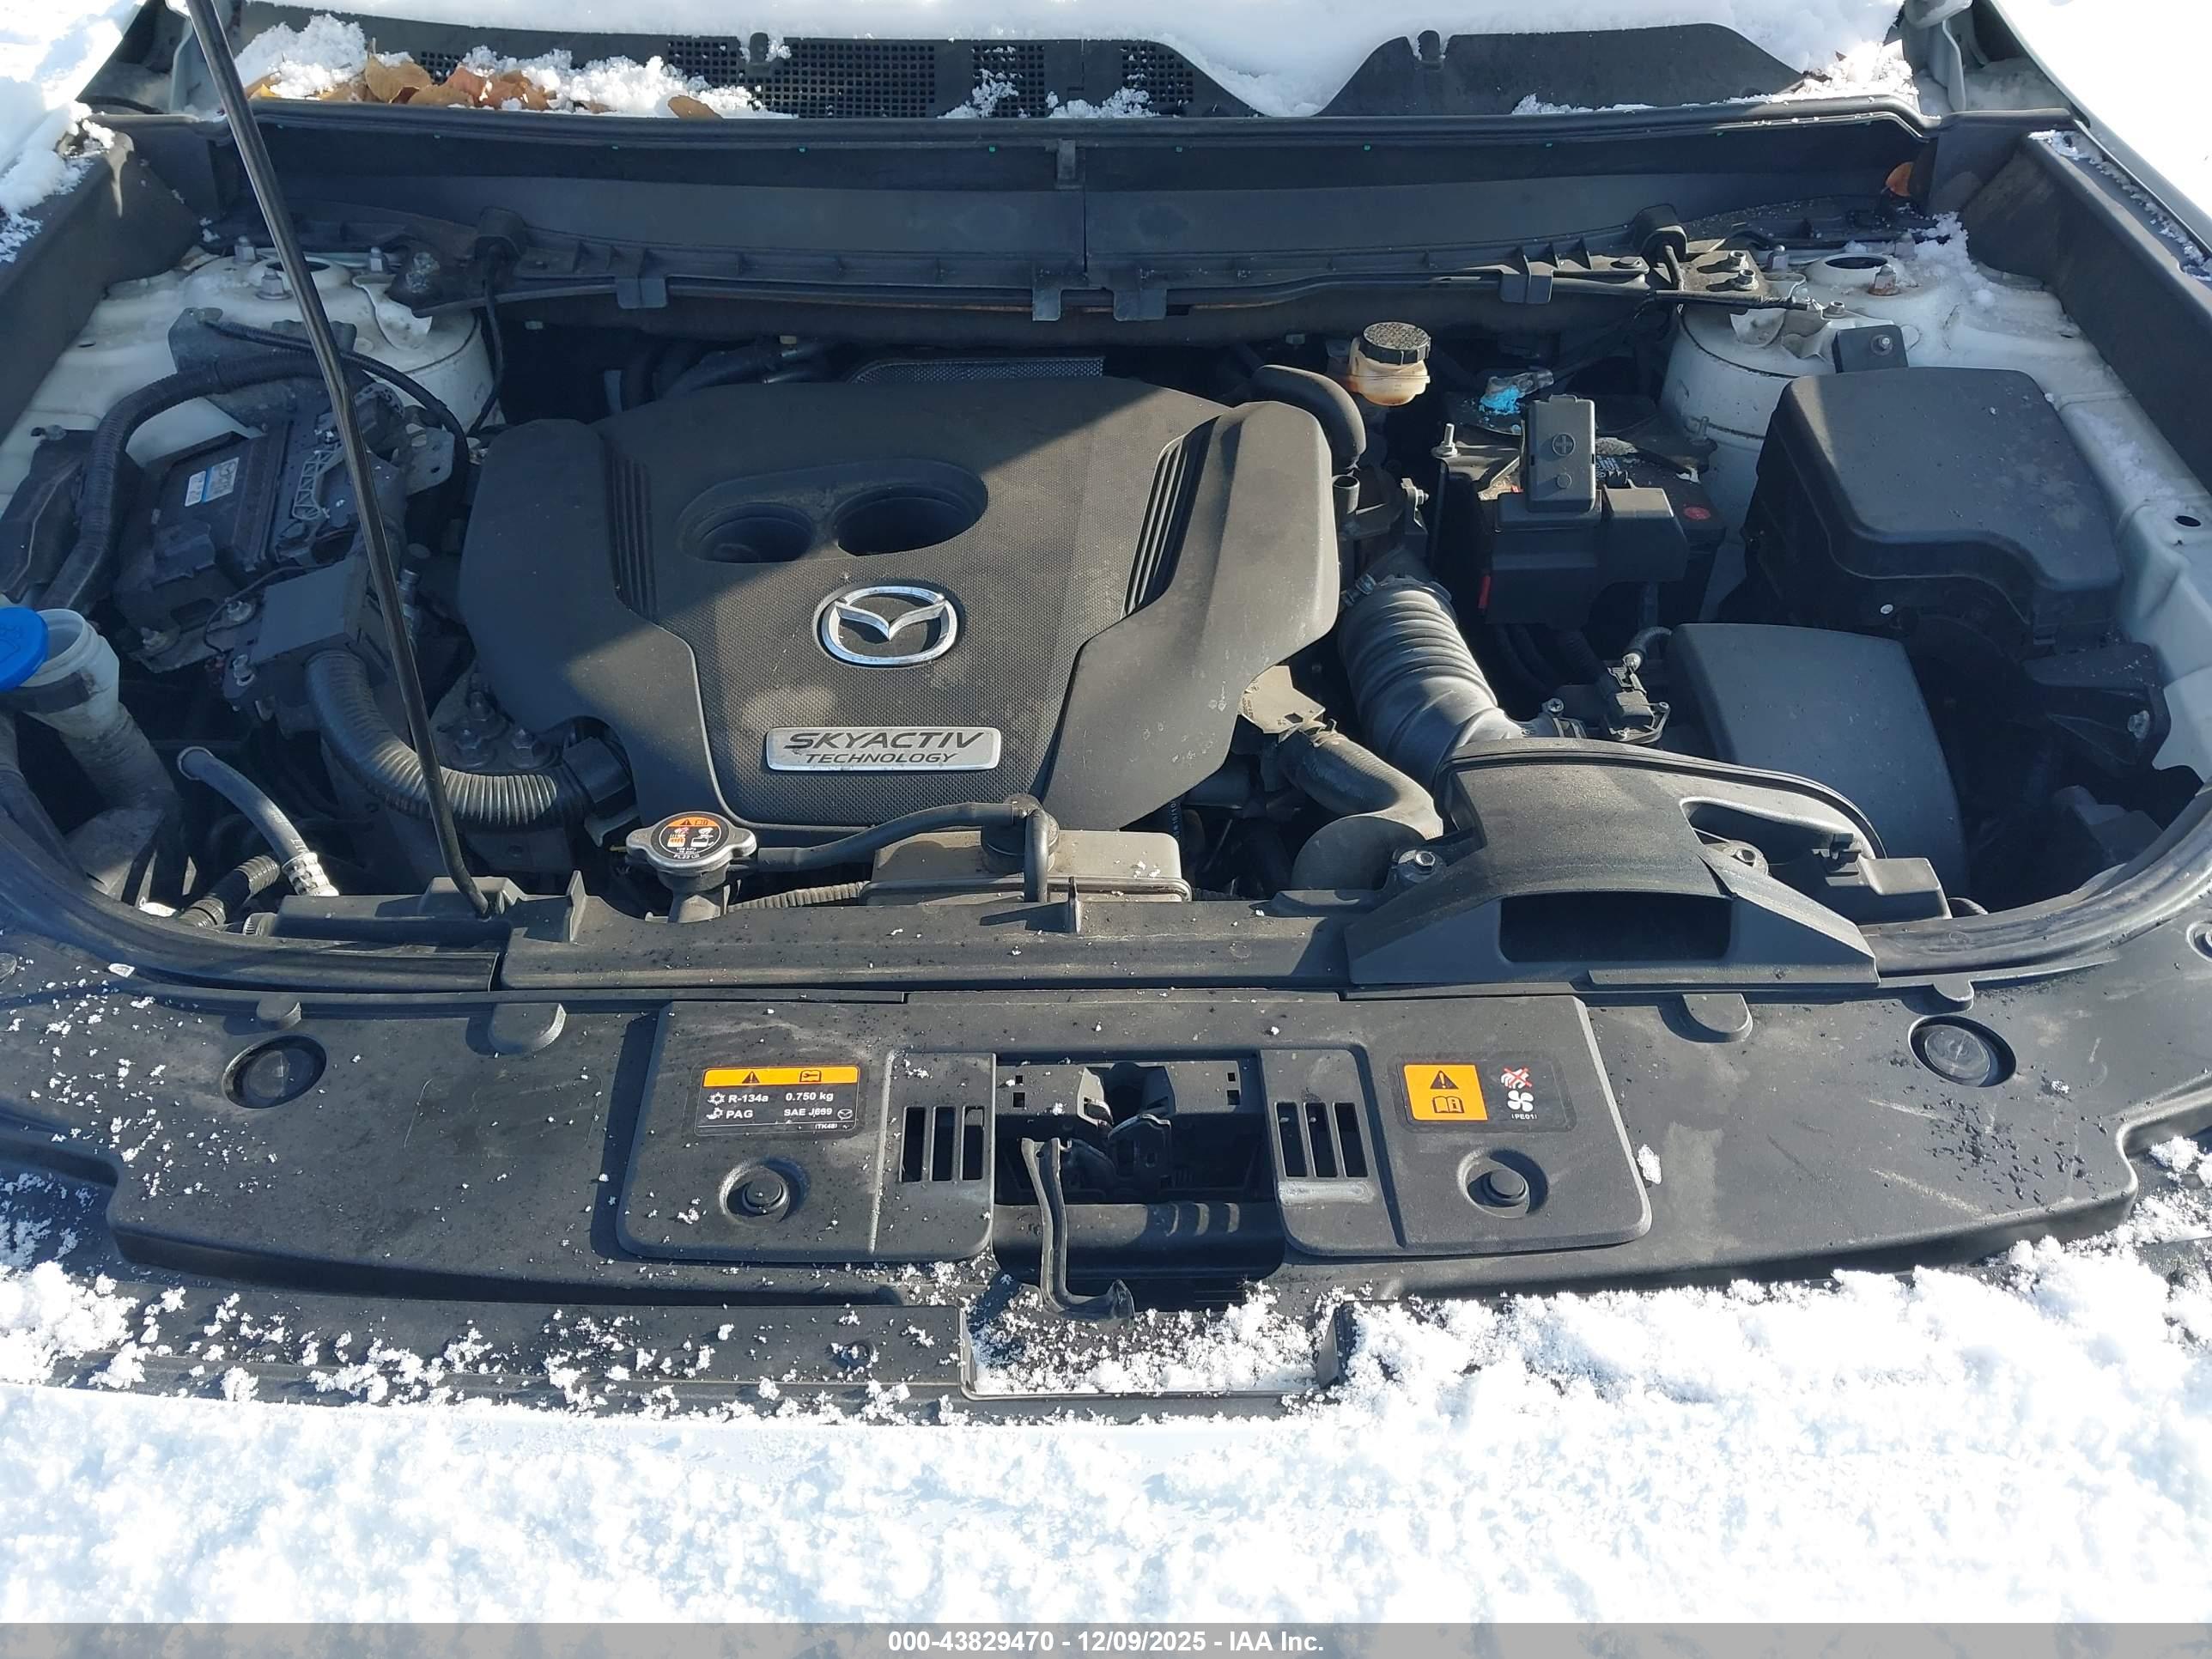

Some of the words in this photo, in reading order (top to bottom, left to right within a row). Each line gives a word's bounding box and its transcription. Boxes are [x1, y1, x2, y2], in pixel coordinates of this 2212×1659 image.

[783, 732, 985, 749] SKYACTIV
[805, 752, 958, 764] TECHNOLOGY
[727, 1094, 769, 1103] R-134a
[786, 1092, 817, 1101] 0.750
[819, 1092, 834, 1102] kg
[726, 1110, 753, 1119] PAG
